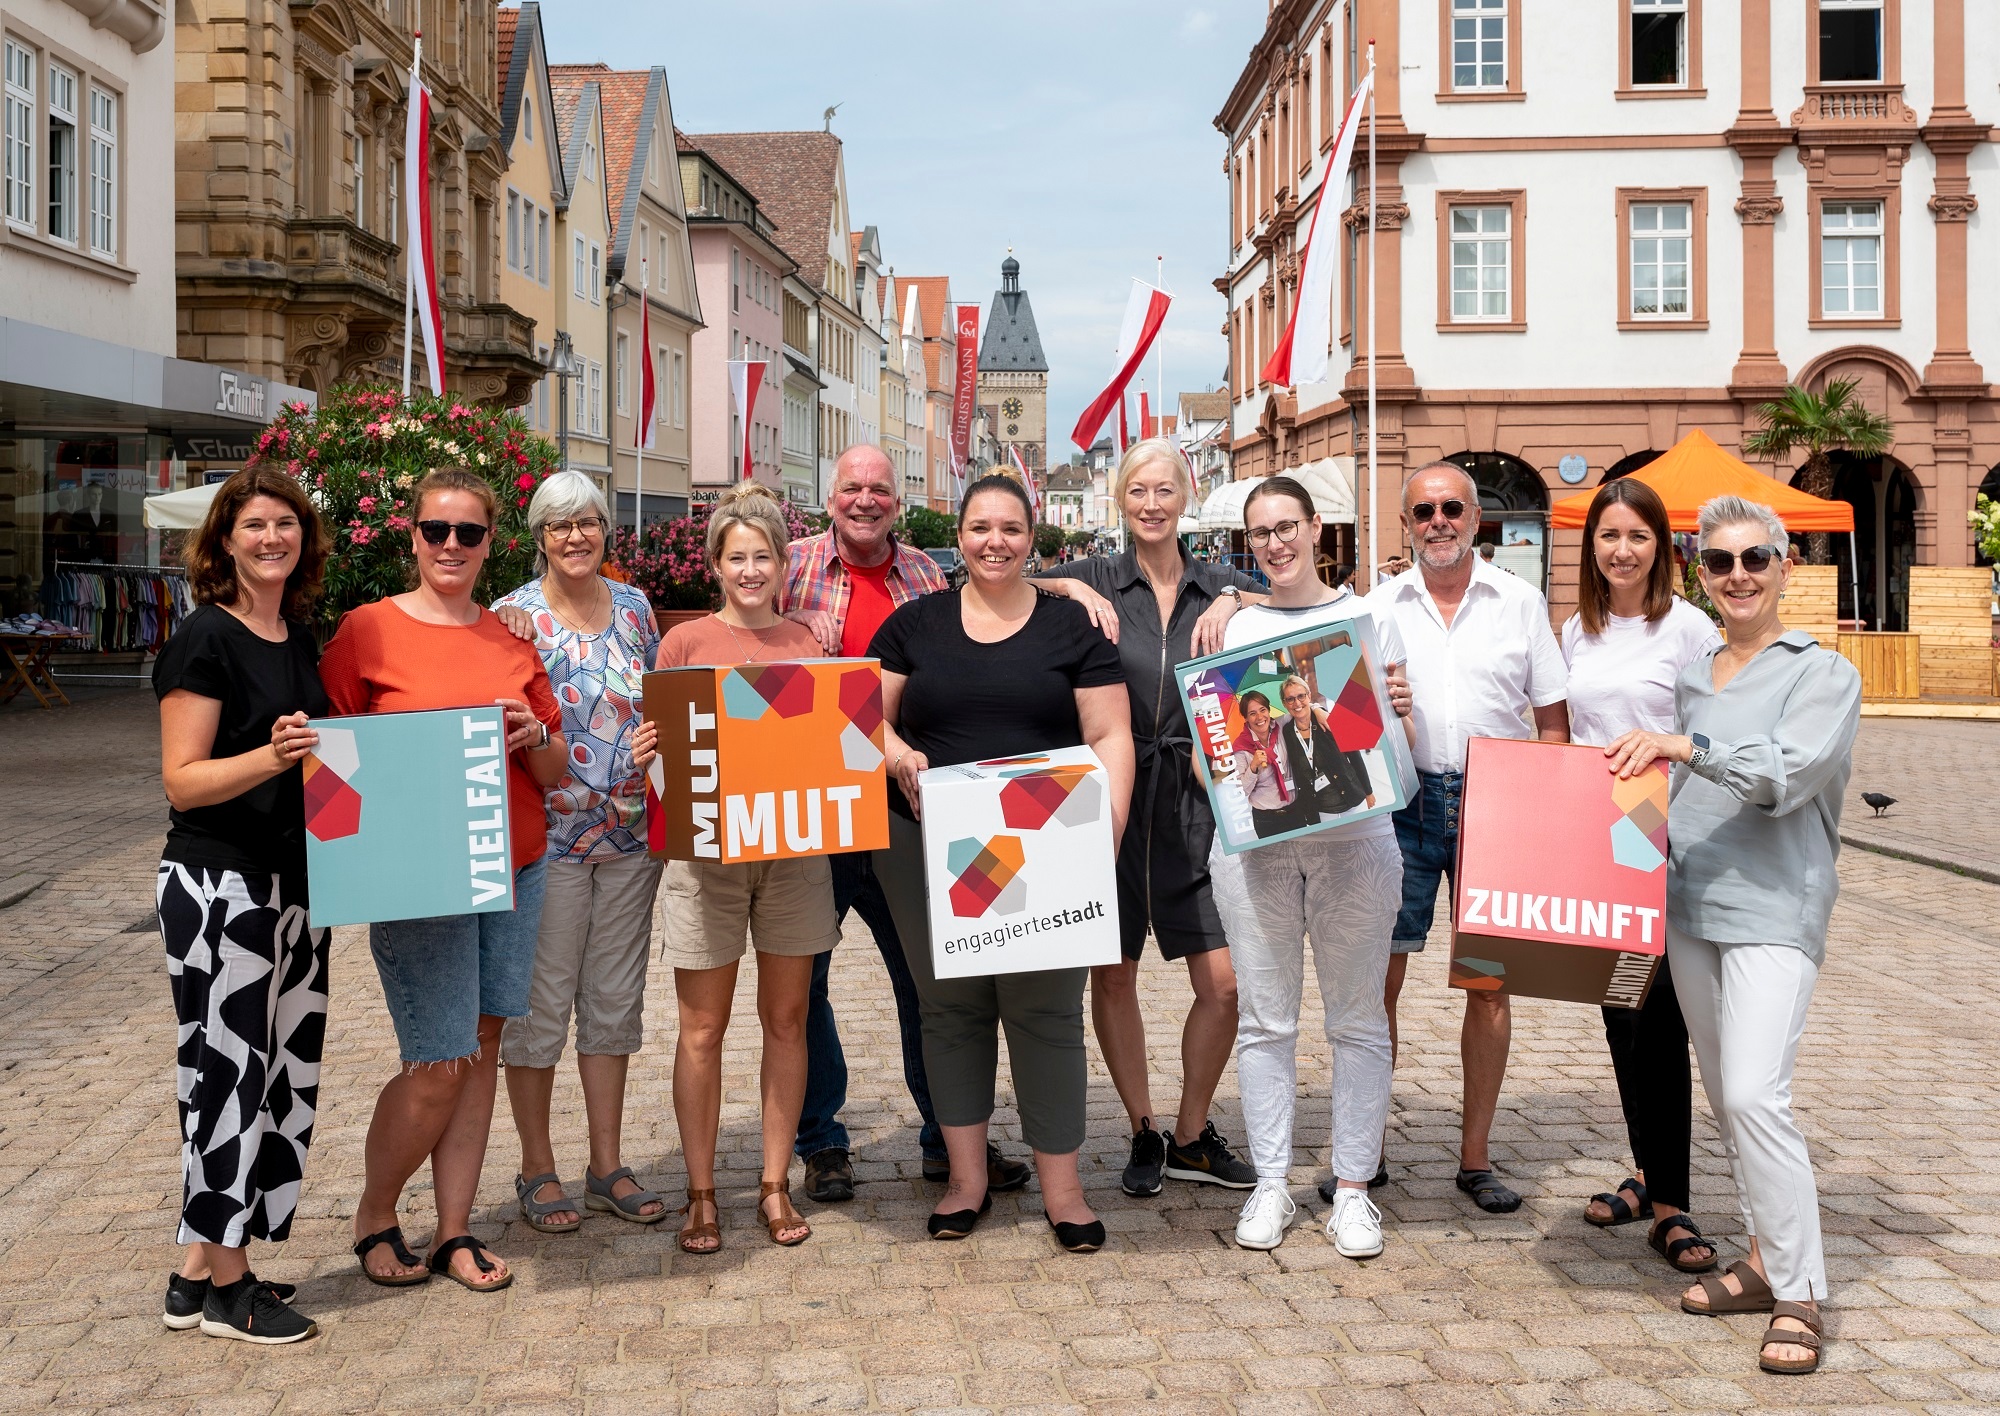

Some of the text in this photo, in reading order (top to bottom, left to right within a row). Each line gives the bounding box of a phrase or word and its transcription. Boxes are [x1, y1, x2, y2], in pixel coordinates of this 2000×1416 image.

[215, 371, 265, 418] Schmitt
[955, 348, 973, 445] CHRISTMANN
[688, 701, 720, 859] MUT
[1195, 680, 1254, 834] ENGAGEMENT
[462, 716, 507, 907] VIELFALT
[725, 785, 862, 858] MUT
[945, 900, 1105, 954] engagiertestadt
[1463, 887, 1660, 944] ZUKUNFT
[1603, 952, 1657, 1008] ZUKUNFT
